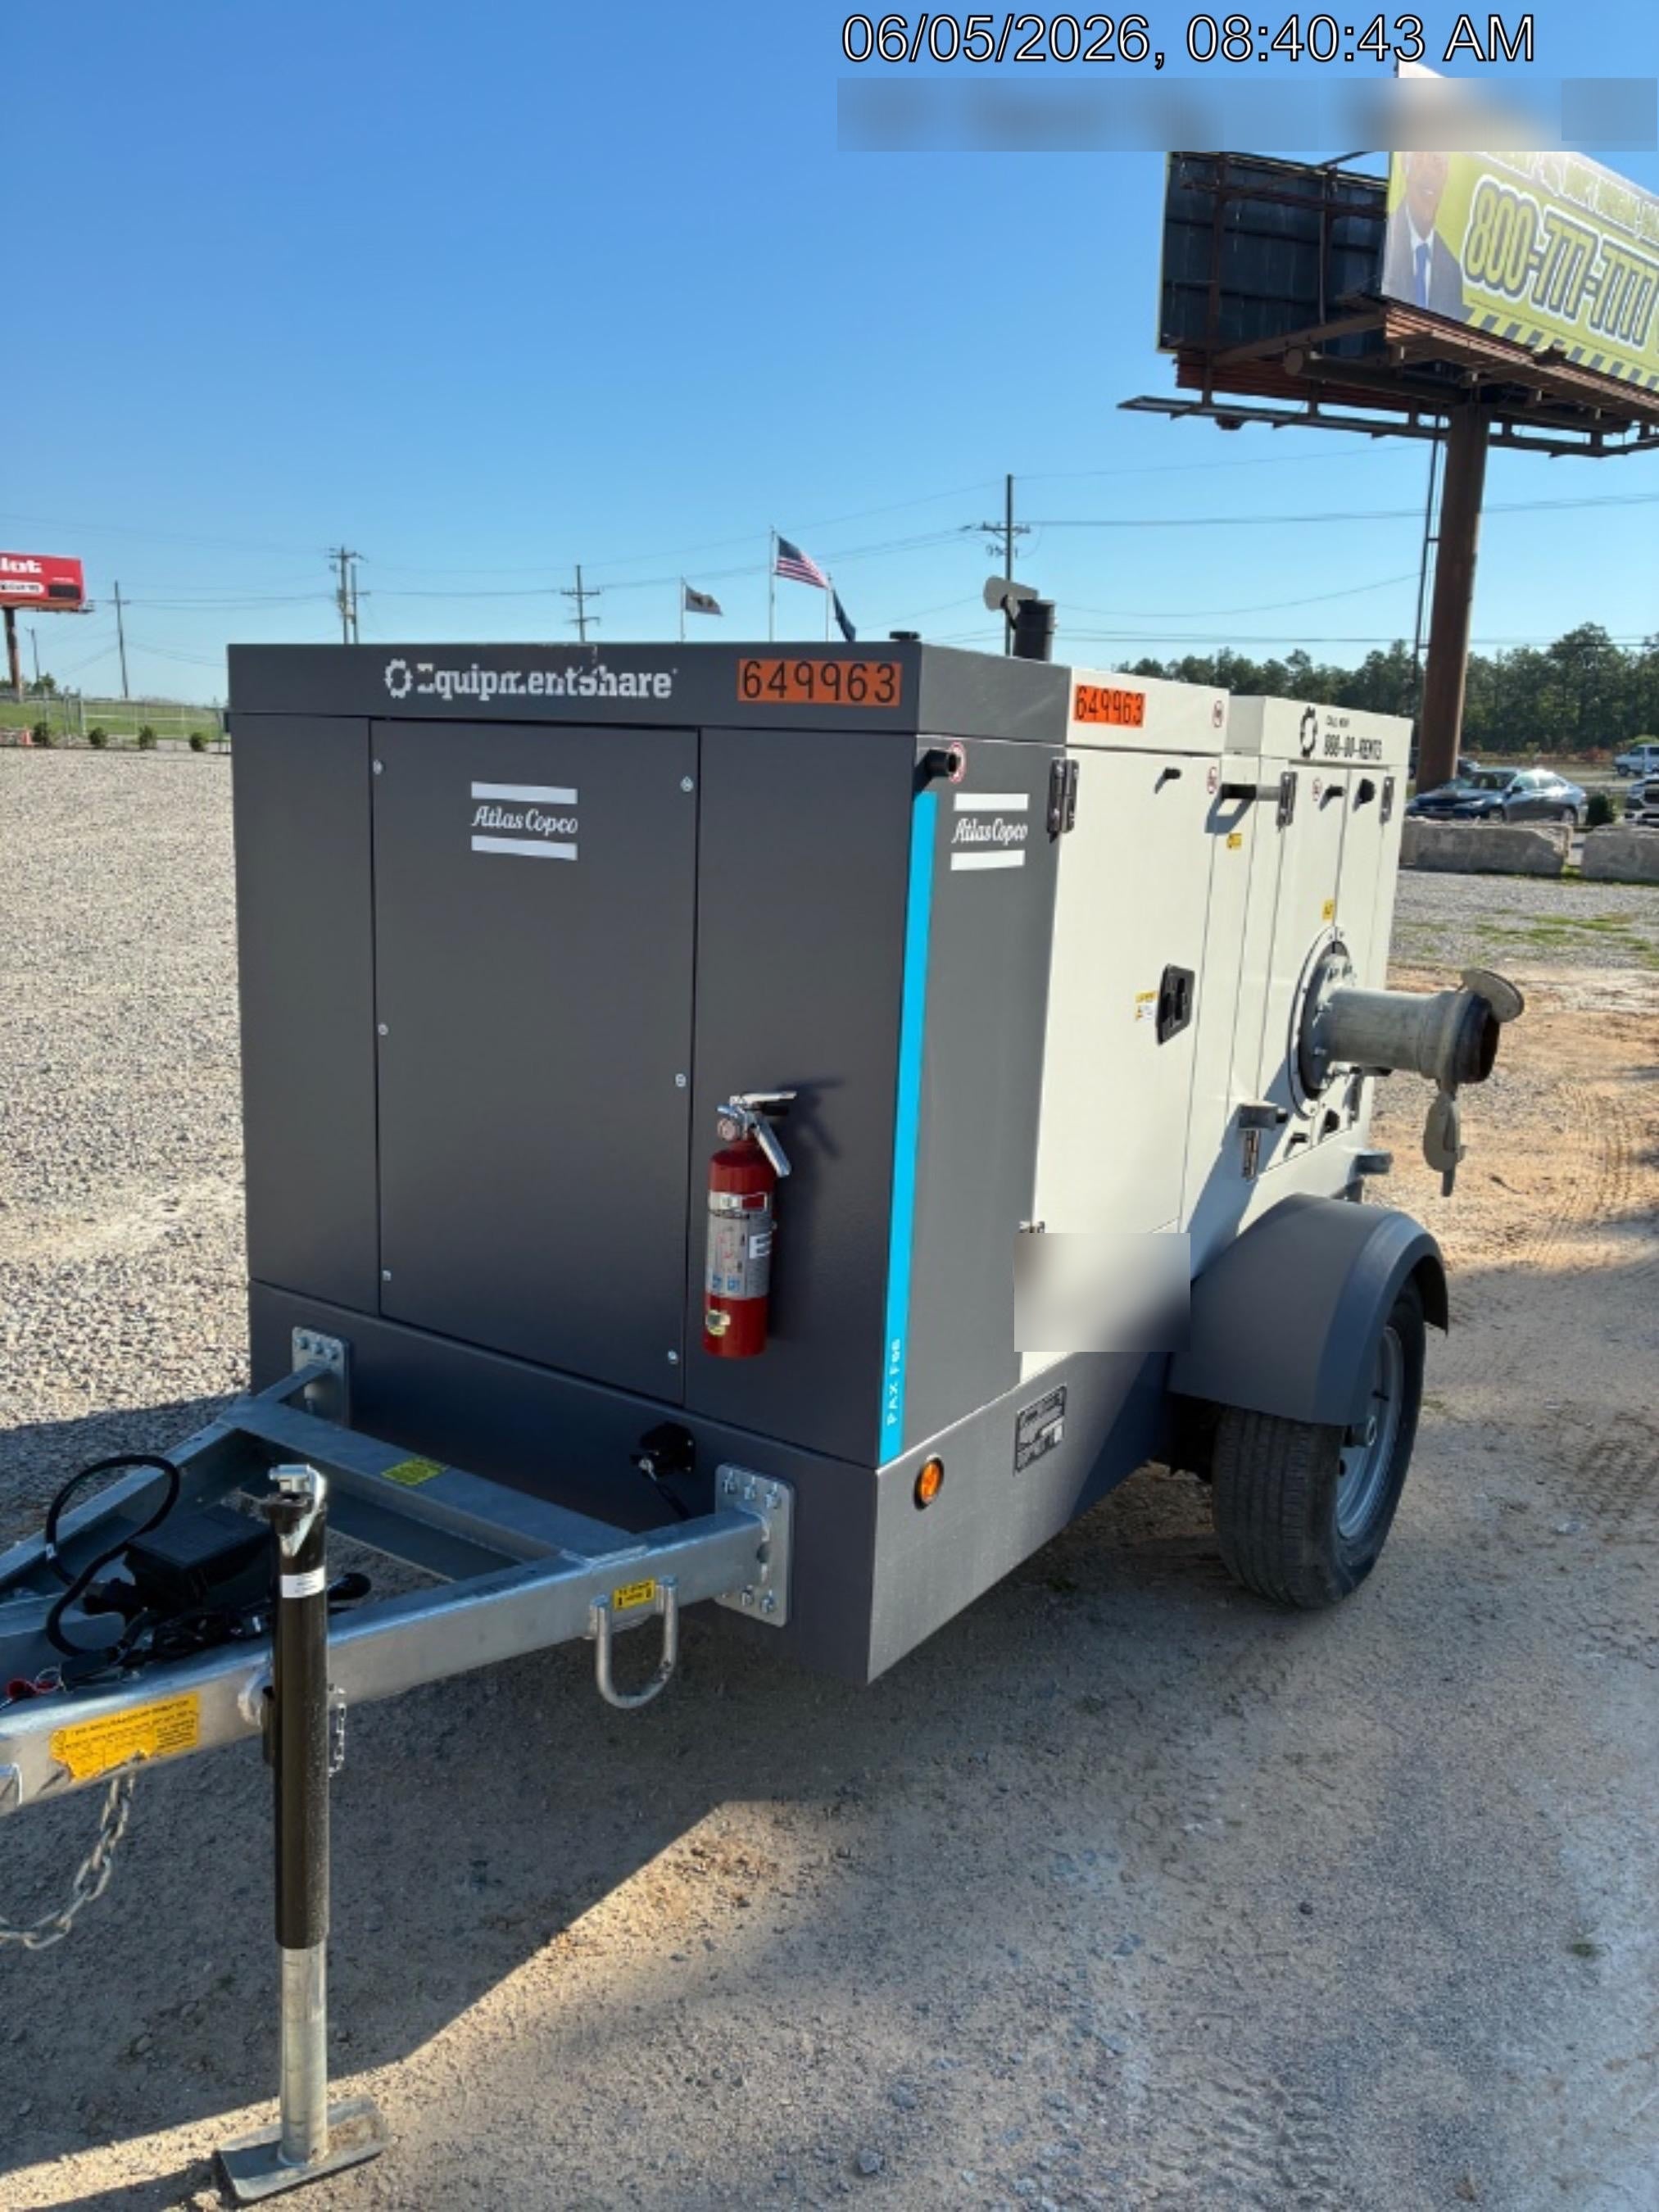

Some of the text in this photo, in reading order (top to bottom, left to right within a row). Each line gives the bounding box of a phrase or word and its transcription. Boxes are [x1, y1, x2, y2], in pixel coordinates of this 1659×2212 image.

[743, 660, 895, 703] 649963
[1076, 685, 1145, 727] 649963
[471, 805, 578, 836] Atlas Copco
[951, 818, 1028, 846] Atlas Copco
